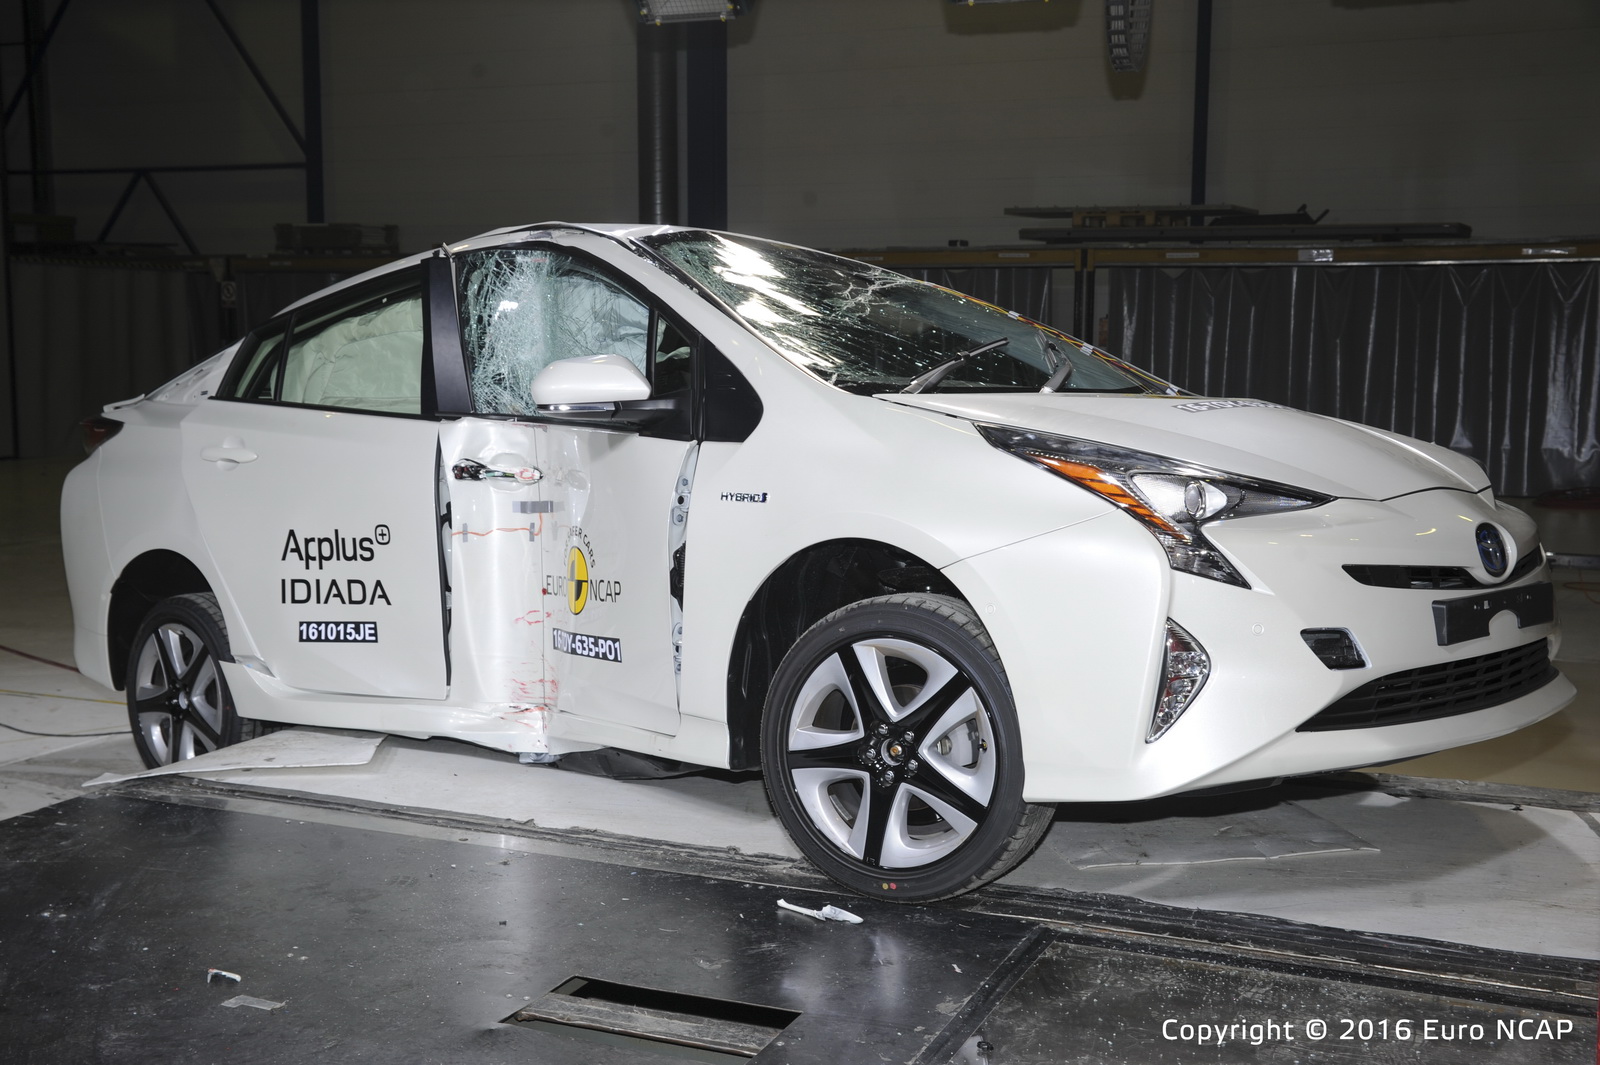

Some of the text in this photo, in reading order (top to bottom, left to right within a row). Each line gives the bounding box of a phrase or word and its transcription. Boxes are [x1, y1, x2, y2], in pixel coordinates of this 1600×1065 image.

[582, 533, 596, 568] CARS
[281, 578, 392, 606] IDIADA
[546, 574, 622, 603] EURO NCAP
[299, 622, 376, 640] 161015JE
